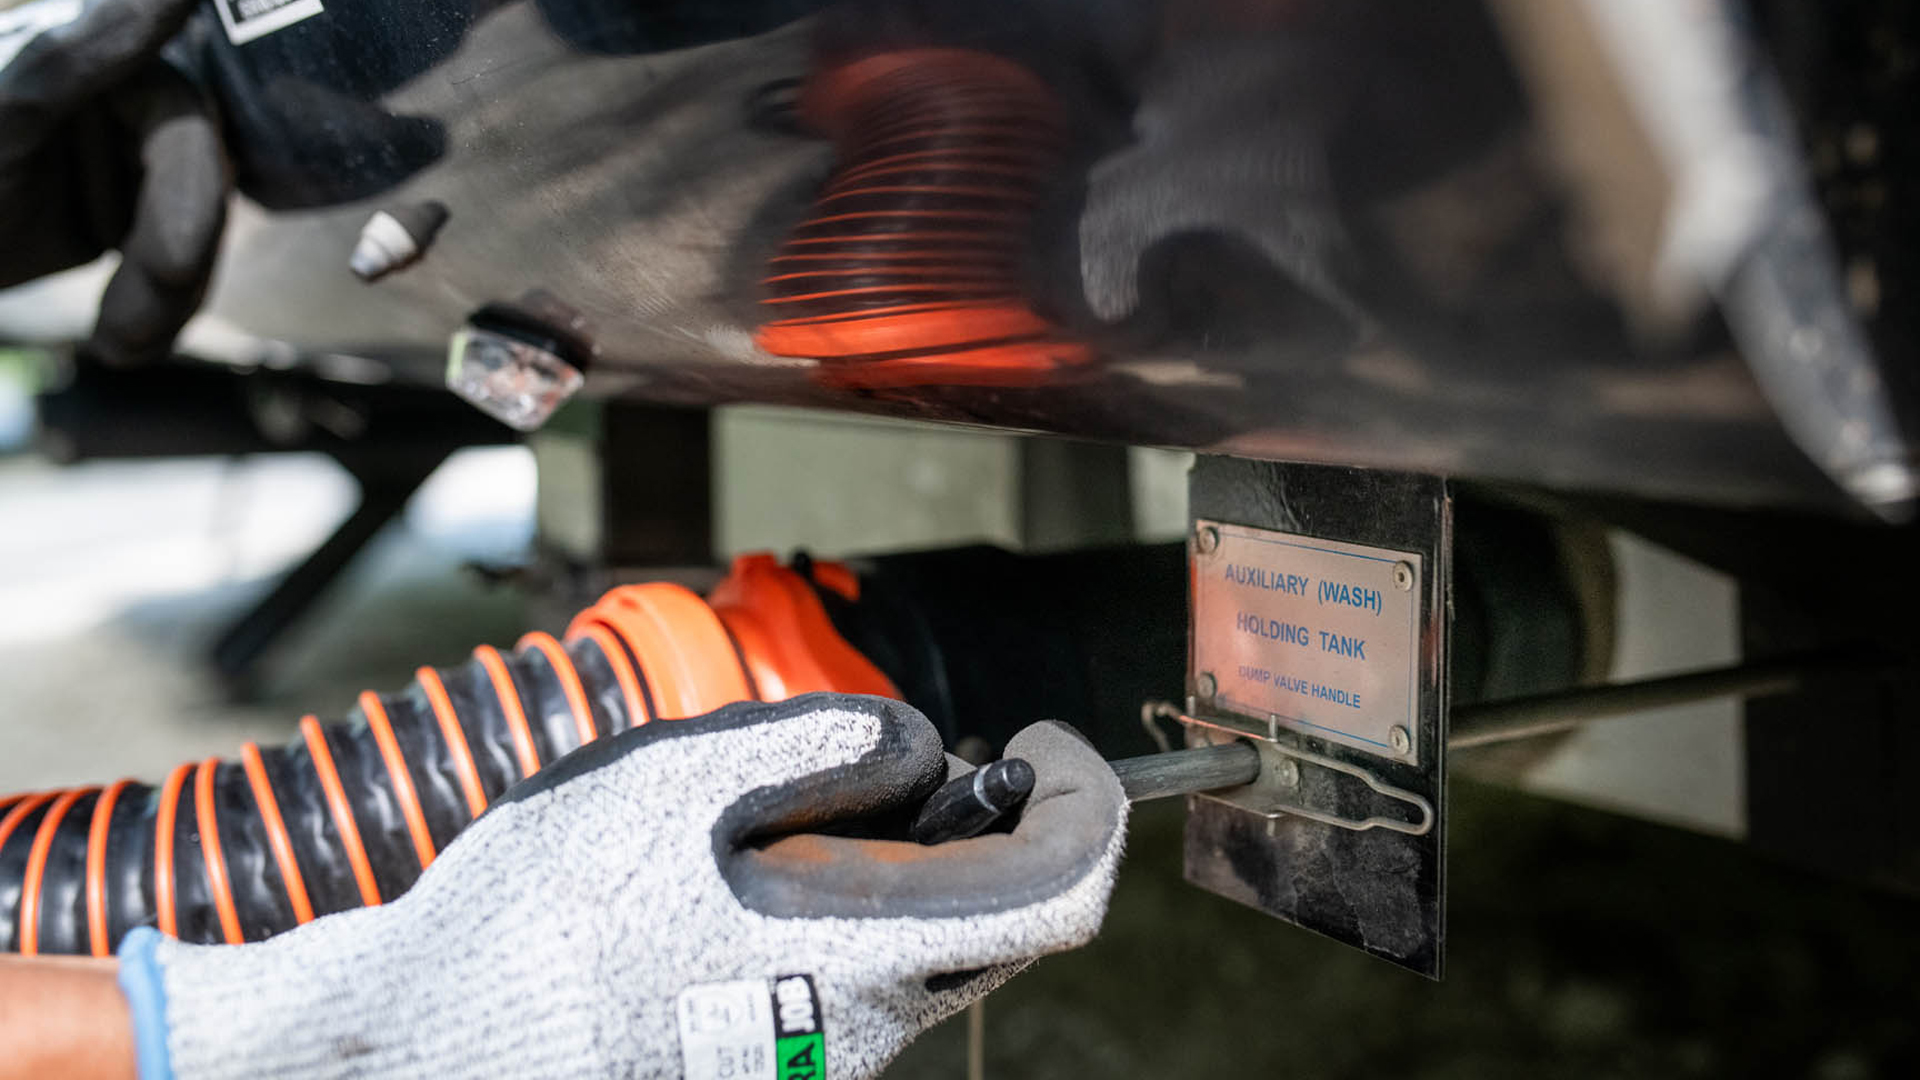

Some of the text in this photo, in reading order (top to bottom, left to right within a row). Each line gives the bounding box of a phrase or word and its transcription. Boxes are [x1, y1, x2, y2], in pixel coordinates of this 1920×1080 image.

[1225, 564, 1382, 616] AUXILIARY (WASH)
[1237, 611, 1366, 661] HOLDING TANK
[1239, 665, 1361, 709] DUMP VALVE HANDLE
[777, 976, 816, 1033] JOB
